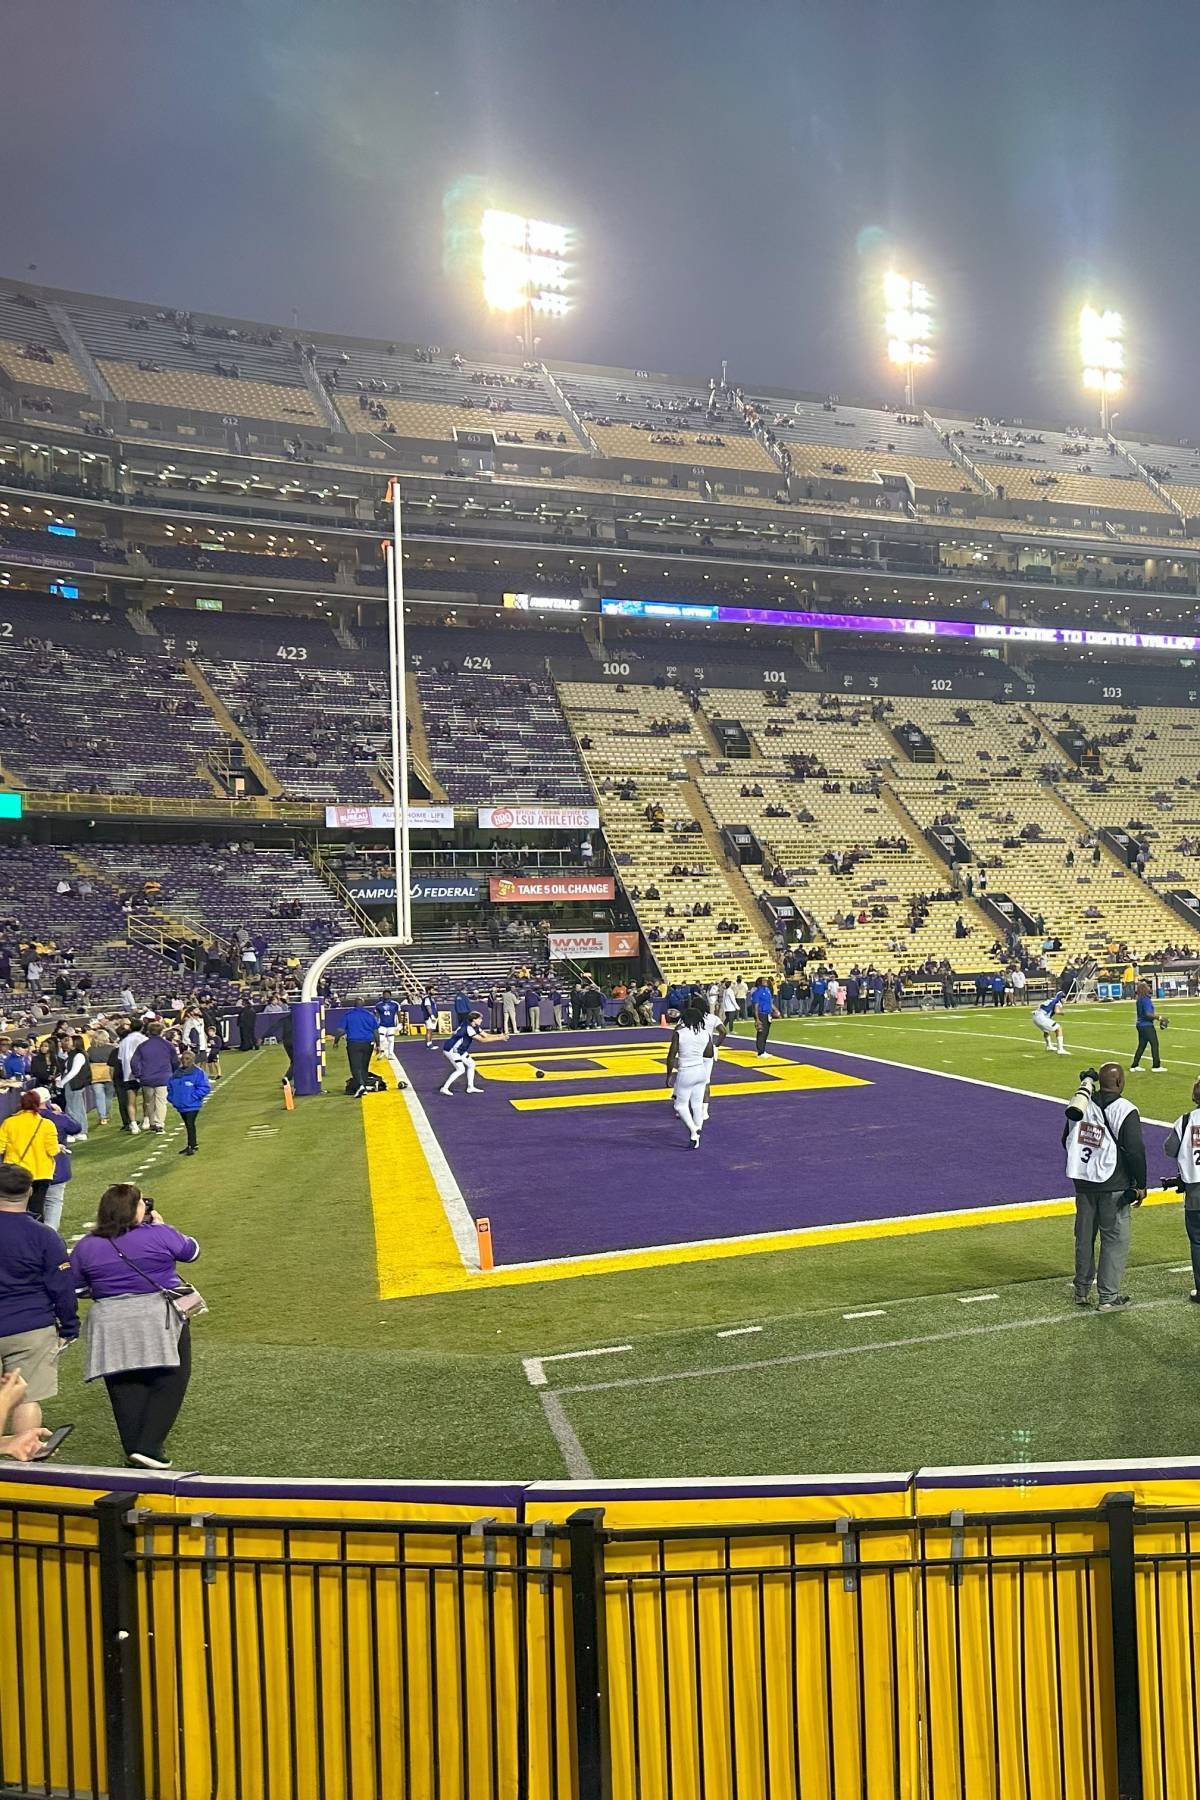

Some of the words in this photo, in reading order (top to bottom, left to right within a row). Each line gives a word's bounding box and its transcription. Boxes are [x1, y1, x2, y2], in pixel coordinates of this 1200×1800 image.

[975, 624, 1056, 641] WELCOME
[1062, 628, 1082, 642] TO
[1086, 630, 1135, 645] DEATH
[1138, 634, 1195, 649] VALLEY
[276, 646, 308, 660] 423
[464, 656, 492, 670] 424
[602, 662, 630, 676] 100
[763, 671, 786, 683] 101
[931, 680, 952, 691] 102
[1102, 688, 1122, 698] 103
[516, 816, 534, 826] LSU
[538, 814, 590, 826] ATHLETICS
[349, 888, 398, 898] CAMPUS
[424, 886, 476, 898] FEDERAL
[518, 884, 542, 895] TAKE
[544, 884, 550, 894] 5
[552, 884, 566, 894] OIL
[567, 884, 608, 894] CHANGE
[552, 938, 602, 946] WWL
[1080, 1147, 1092, 1164] 3
